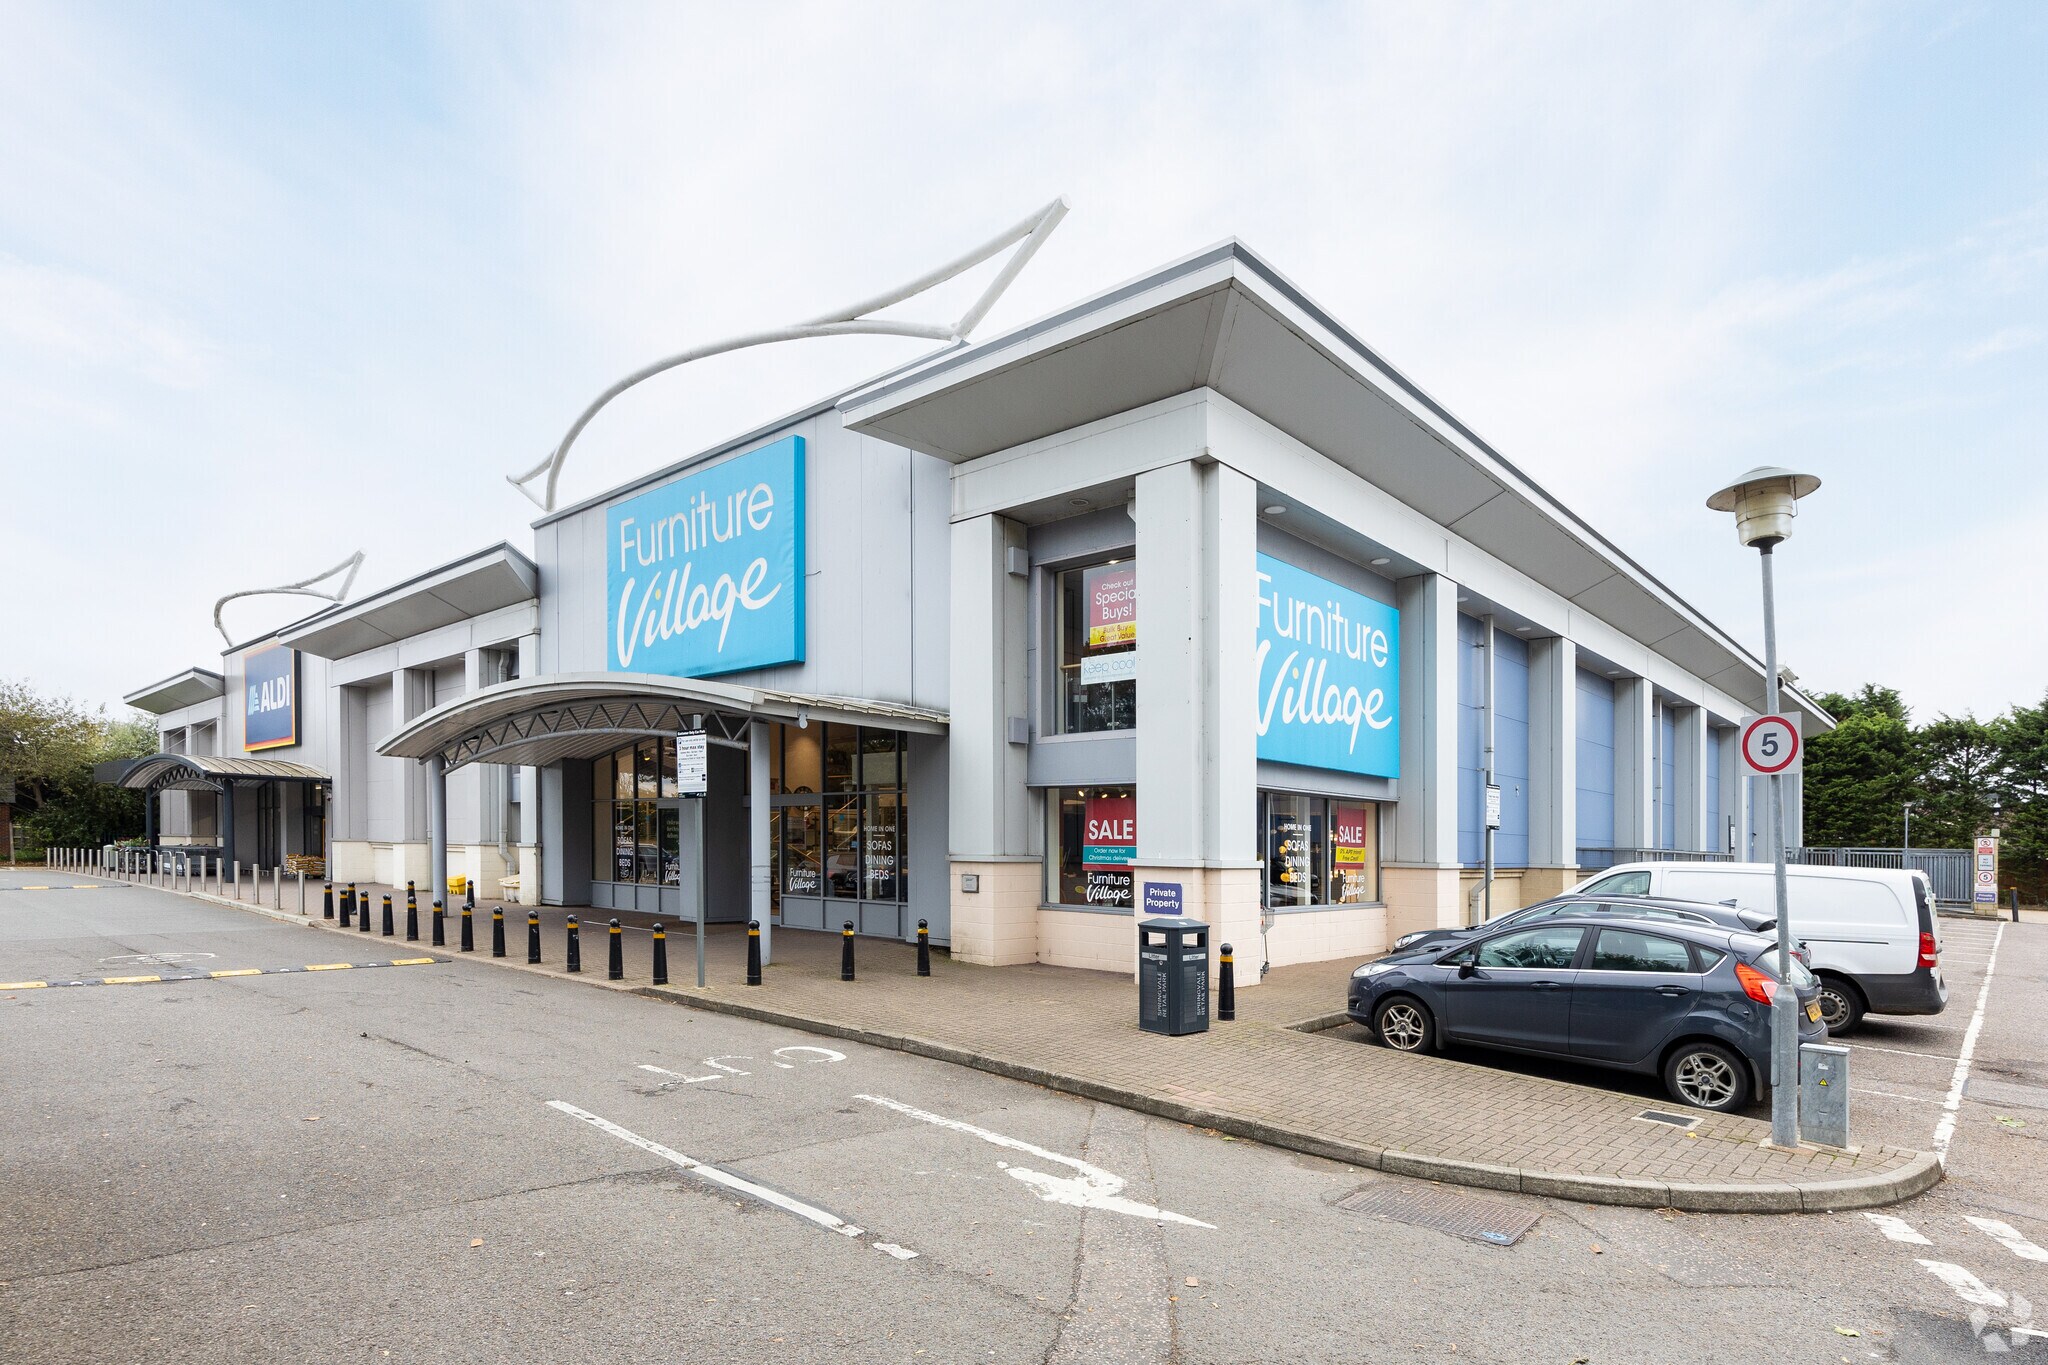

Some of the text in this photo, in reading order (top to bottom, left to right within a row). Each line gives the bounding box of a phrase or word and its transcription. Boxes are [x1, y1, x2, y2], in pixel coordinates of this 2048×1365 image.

[620, 483, 774, 572] Furniture
[1101, 579, 1133, 591] Check out
[1095, 587, 1136, 606] Specia
[617, 557, 782, 668] Village
[1102, 603, 1132, 620] Buys!
[1256, 570, 1388, 668] Furniture
[1117, 632, 1135, 640] Value
[260, 674, 290, 713] ALDI
[1256, 639, 1392, 754] Village
[1761, 732, 1779, 757] 5
[1088, 819, 1134, 840] SALE
[1338, 825, 1363, 843] SALE
[616, 847, 634, 856] DINING
[867, 840, 892, 850] SOFAS
[1094, 847, 1107, 855] Order
[1287, 840, 1309, 851] SOFAS
[619, 858, 631, 867] BEDS
[865, 855, 894, 865] DINING
[1285, 855, 1310, 867] DINING
[664, 870, 681, 884] Villag
[789, 868, 816, 878] Furniture
[870, 869, 889, 880] BEDS
[1087, 872, 1131, 885] Furniture
[1290, 871, 1307, 883] BEDS
[1342, 872, 1365, 883] Furniture
[789, 877, 817, 892] Village
[1341, 883, 1366, 899] Village
[1086, 884, 1132, 904] Village
[1149, 887, 1176, 898] Private
[1146, 897, 1180, 910] Property
